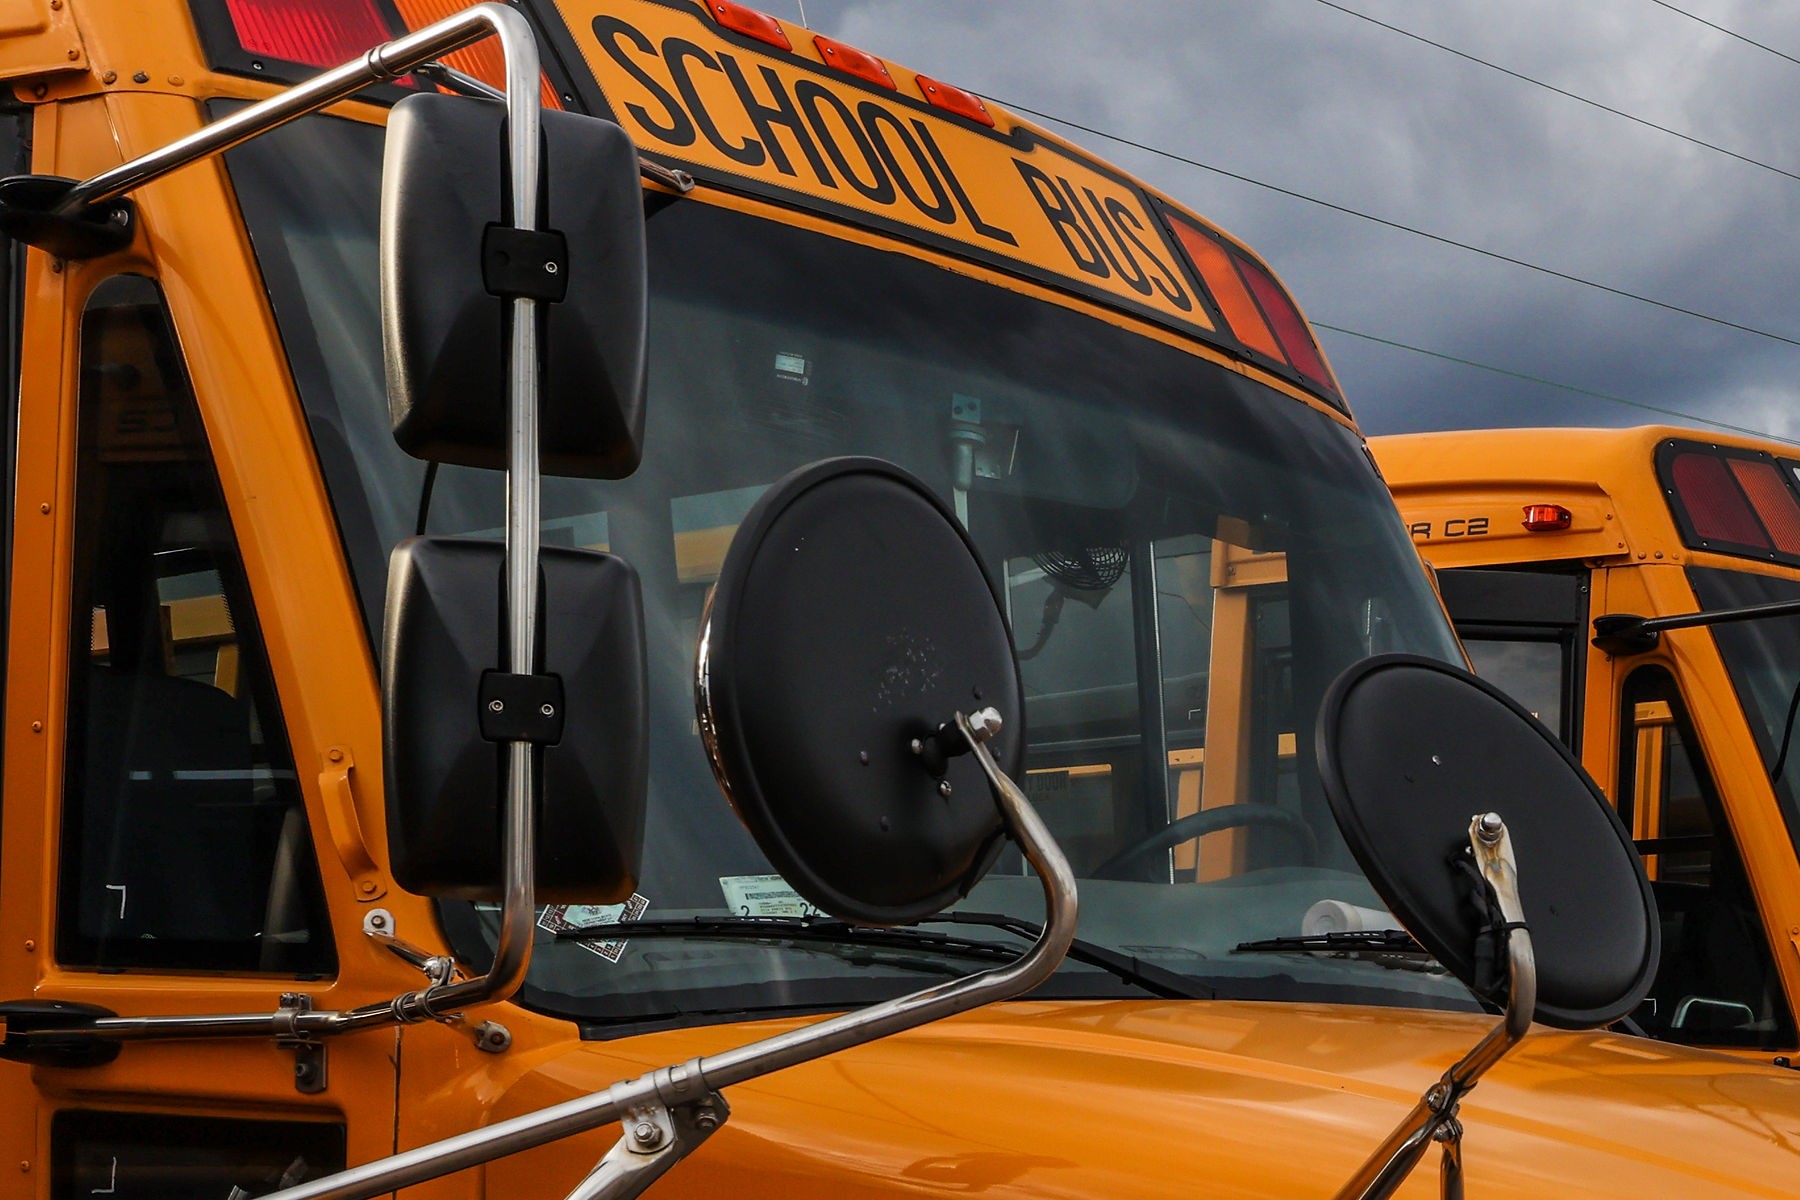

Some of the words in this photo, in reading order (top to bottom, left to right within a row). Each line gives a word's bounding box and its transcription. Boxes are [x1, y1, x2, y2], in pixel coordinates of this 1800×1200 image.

[591, 14, 1020, 248] SCHOOL
[1012, 158, 1194, 313] BUS
[1444, 517, 1489, 537] C2
